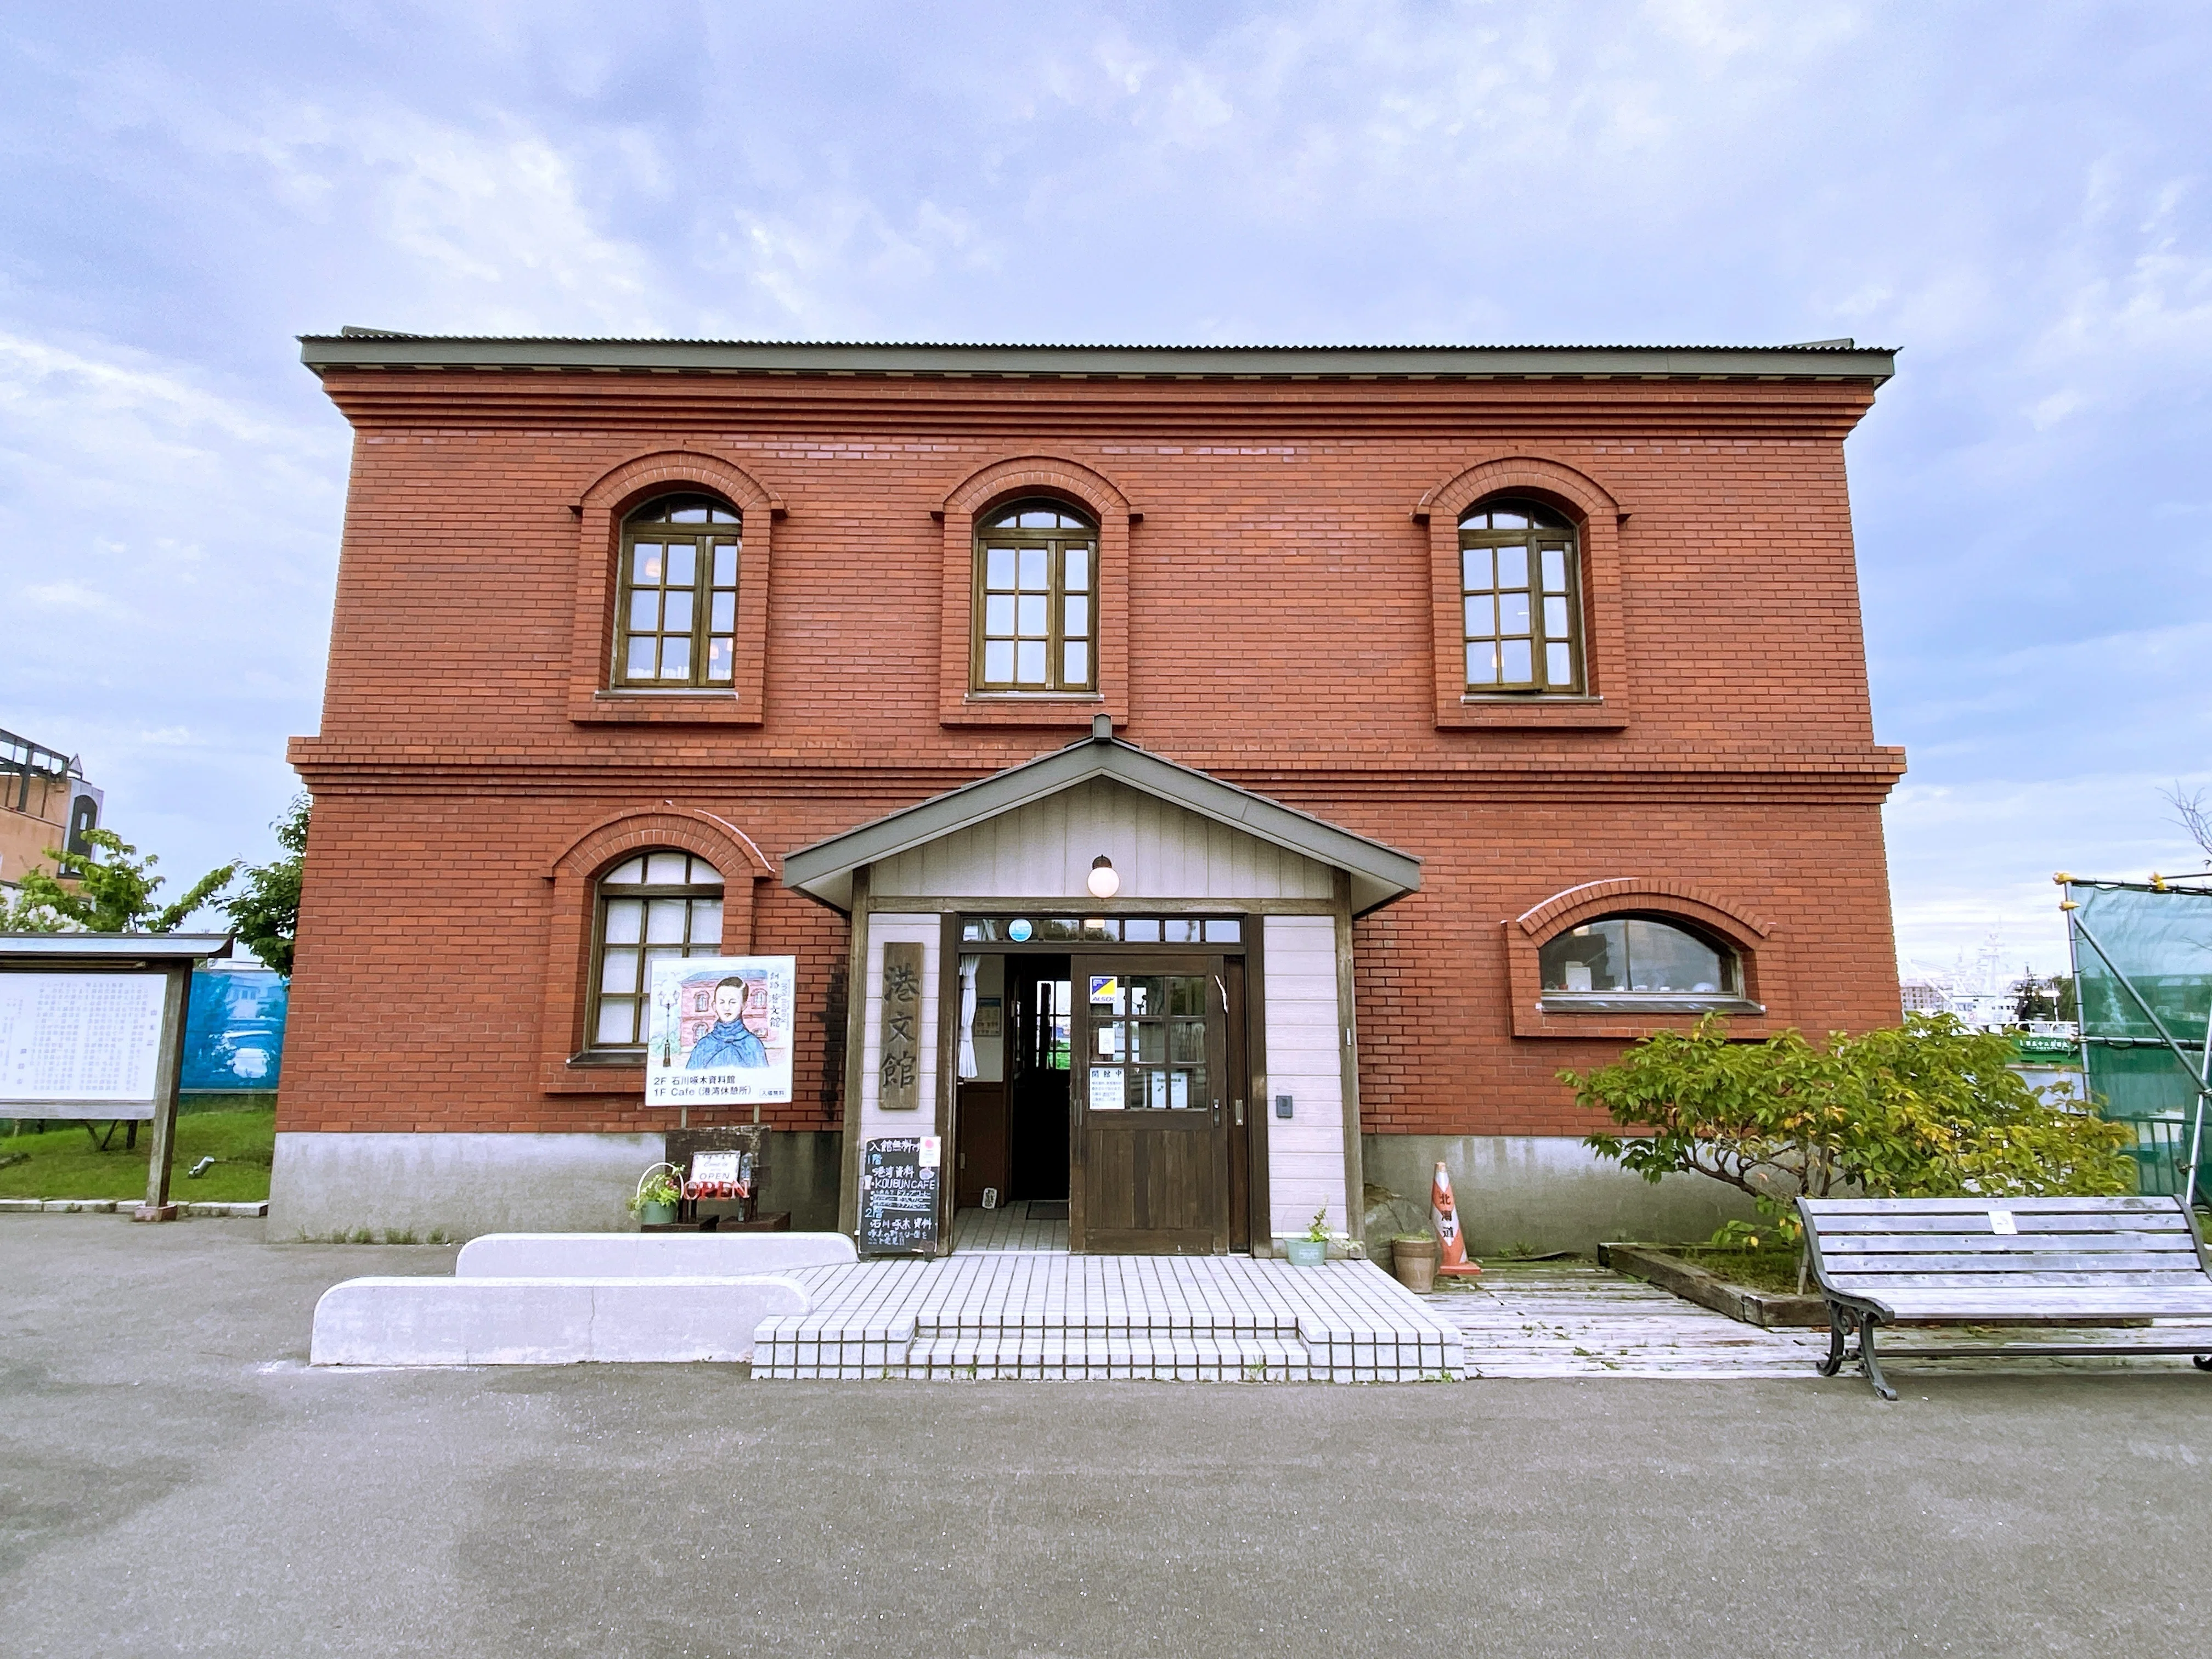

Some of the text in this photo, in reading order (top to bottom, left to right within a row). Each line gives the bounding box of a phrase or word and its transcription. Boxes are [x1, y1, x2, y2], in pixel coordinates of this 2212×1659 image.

[881, 962, 919, 1089] 港文館
[654, 1075, 736, 1086] 2F 石川啄木資料館
[654, 1088, 666, 1097] 1F
[671, 1088, 695, 1096] Cafe
[684, 1181, 750, 1201] OPEN
